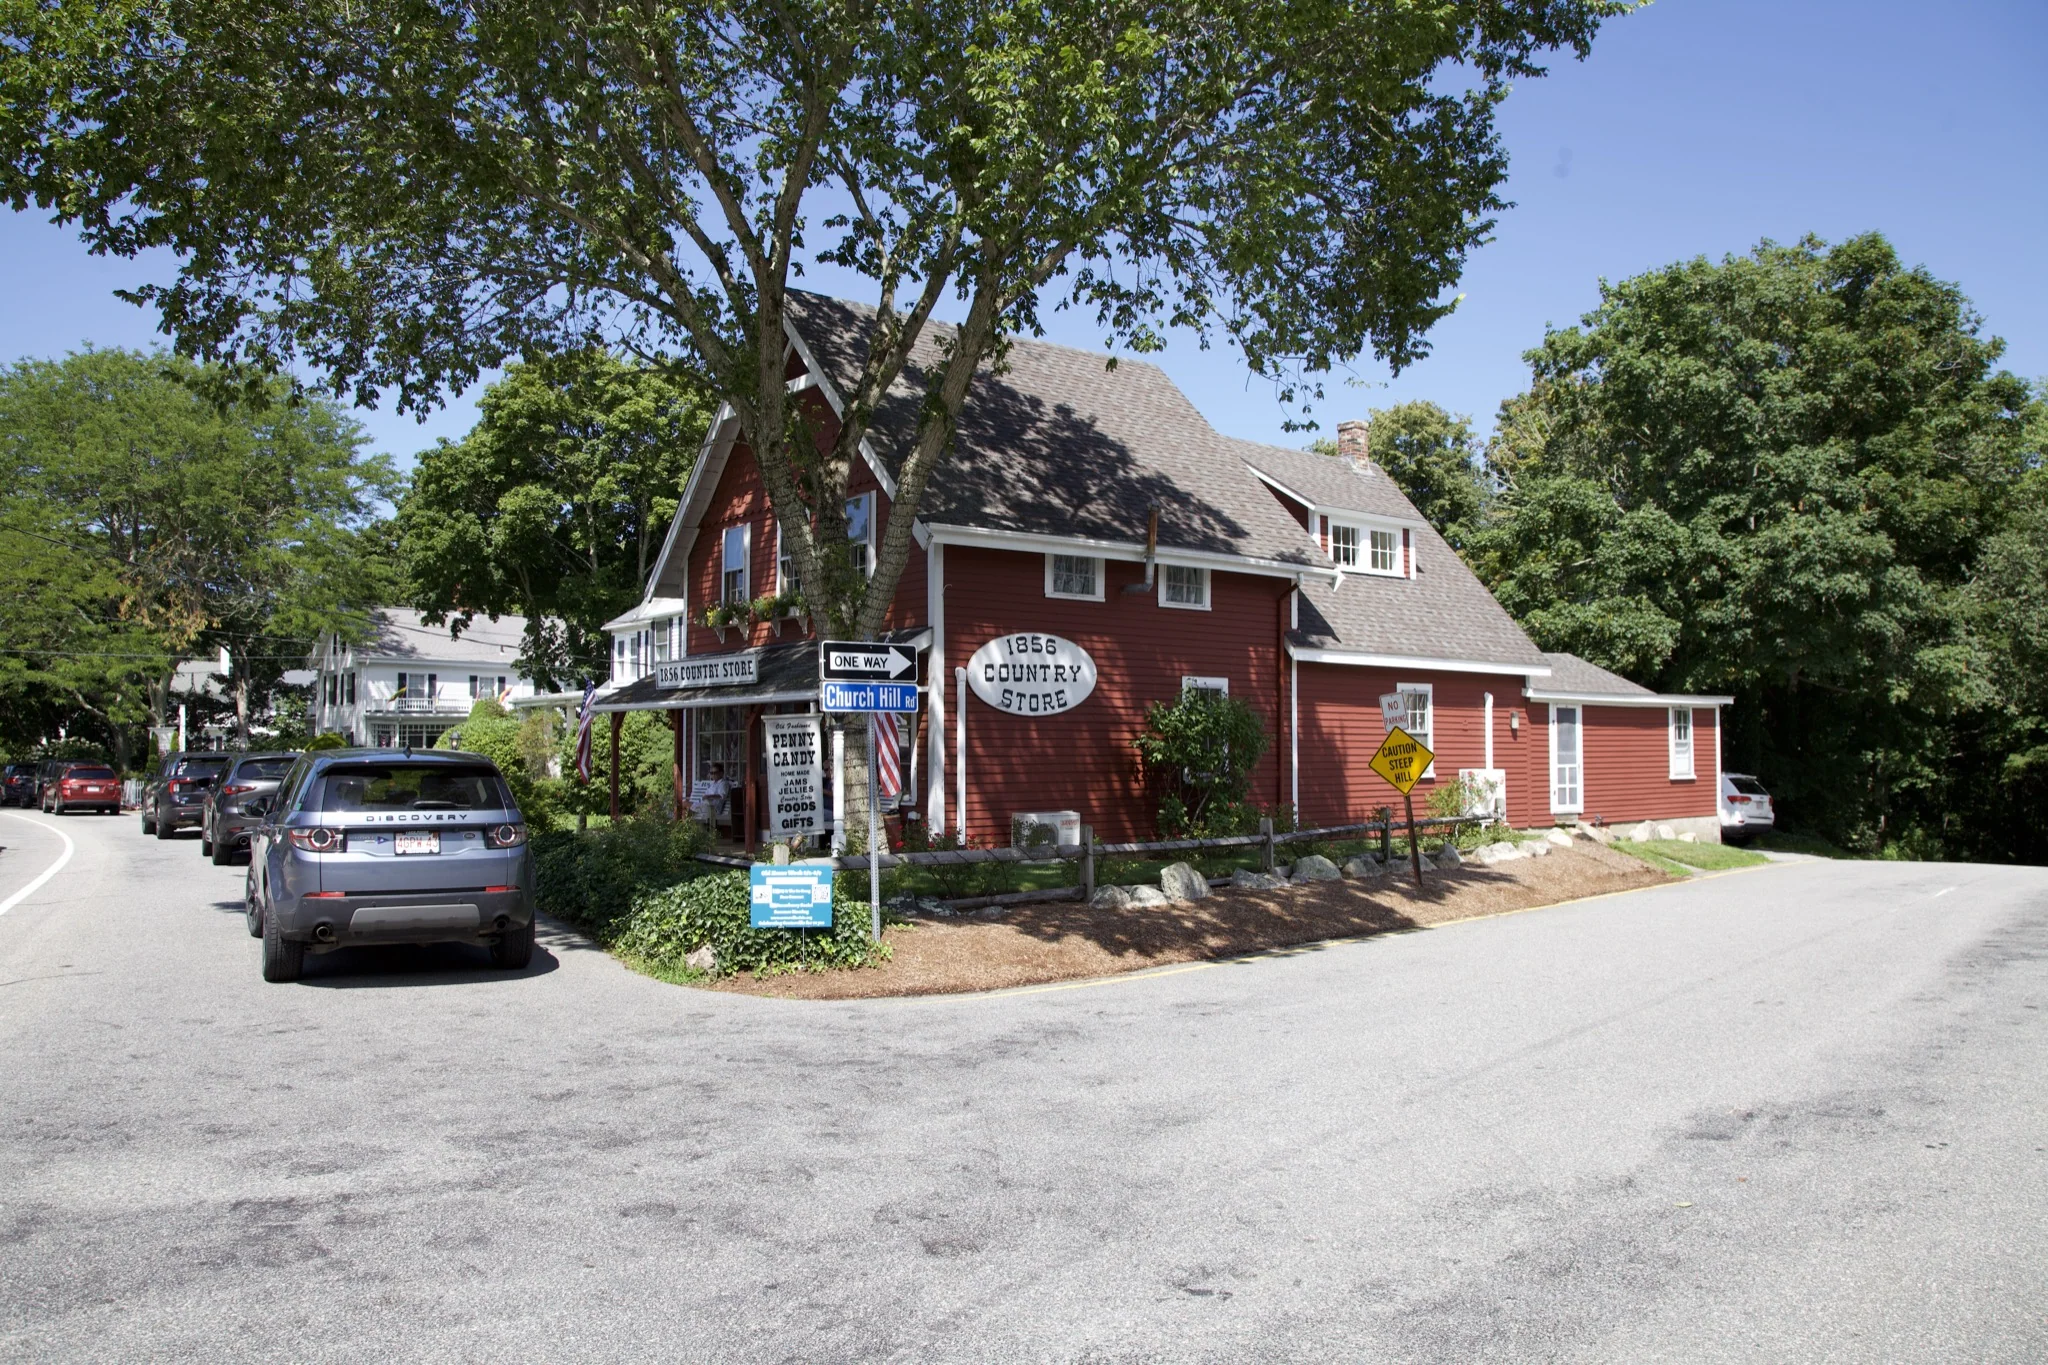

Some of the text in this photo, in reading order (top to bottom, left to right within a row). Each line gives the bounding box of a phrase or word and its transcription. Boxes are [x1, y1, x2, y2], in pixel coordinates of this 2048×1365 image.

[1006, 635, 1057, 656] 1856
[834, 655, 888, 669] ONE WAY
[660, 660, 753, 682] 1856 COUNTRY STORE
[984, 663, 1081, 683] COUNTRY
[826, 685, 915, 709] Church Hill Rd
[1001, 688, 1068, 712] STORE
[1387, 700, 1399, 711] NO
[1385, 715, 1406, 725] PARKING
[772, 732, 815, 749] PENNY
[1382, 743, 1417, 757] CAUTION
[773, 750, 816, 767] CANDY
[1389, 757, 1413, 770] STEEP
[784, 778, 808, 786] JAMS
[1395, 771, 1413, 783] HILL
[778, 785, 814, 795] JELLIES
[777, 801, 816, 813] FOODS
[781, 817, 814, 829] GIFTS
